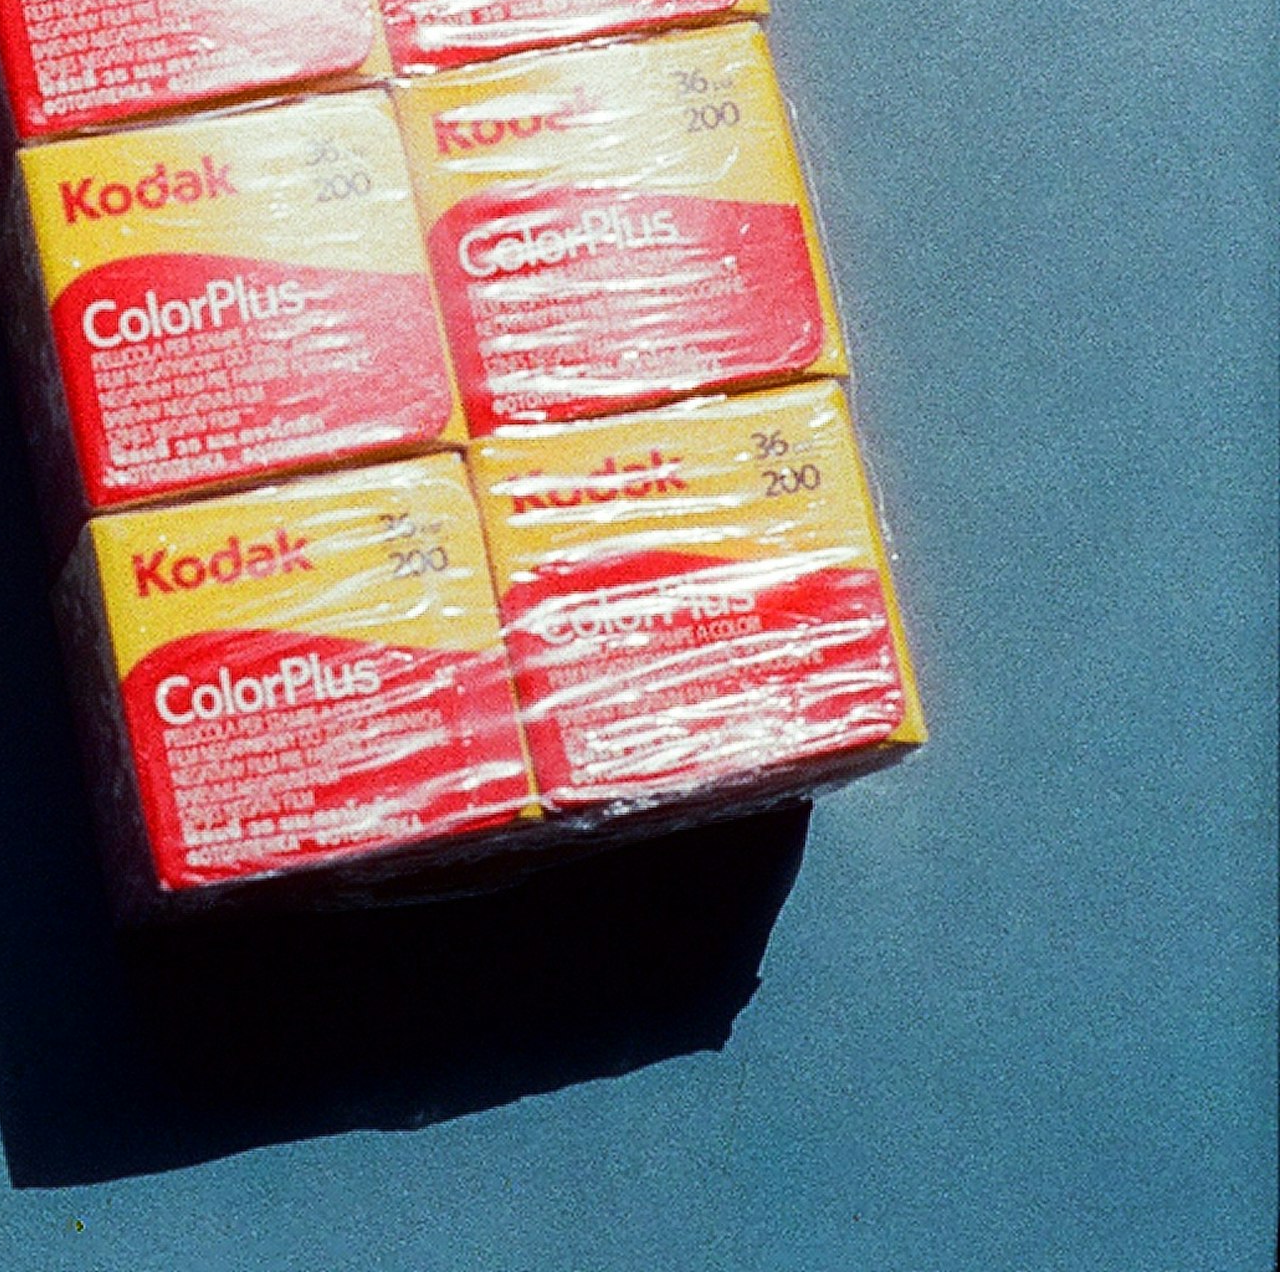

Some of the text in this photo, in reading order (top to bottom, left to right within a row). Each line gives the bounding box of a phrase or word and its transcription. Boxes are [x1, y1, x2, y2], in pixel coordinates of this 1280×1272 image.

[673, 68, 708, 95] 36
[686, 101, 740, 132] 200
[58, 154, 238, 224] Kodak
[82, 273, 307, 350] ColorPlus
[751, 430, 790, 460] 36
[761, 464, 821, 498] 200
[130, 528, 314, 599] Kodak
[387, 545, 450, 580] 200
[155, 652, 383, 726] ColorPlus
